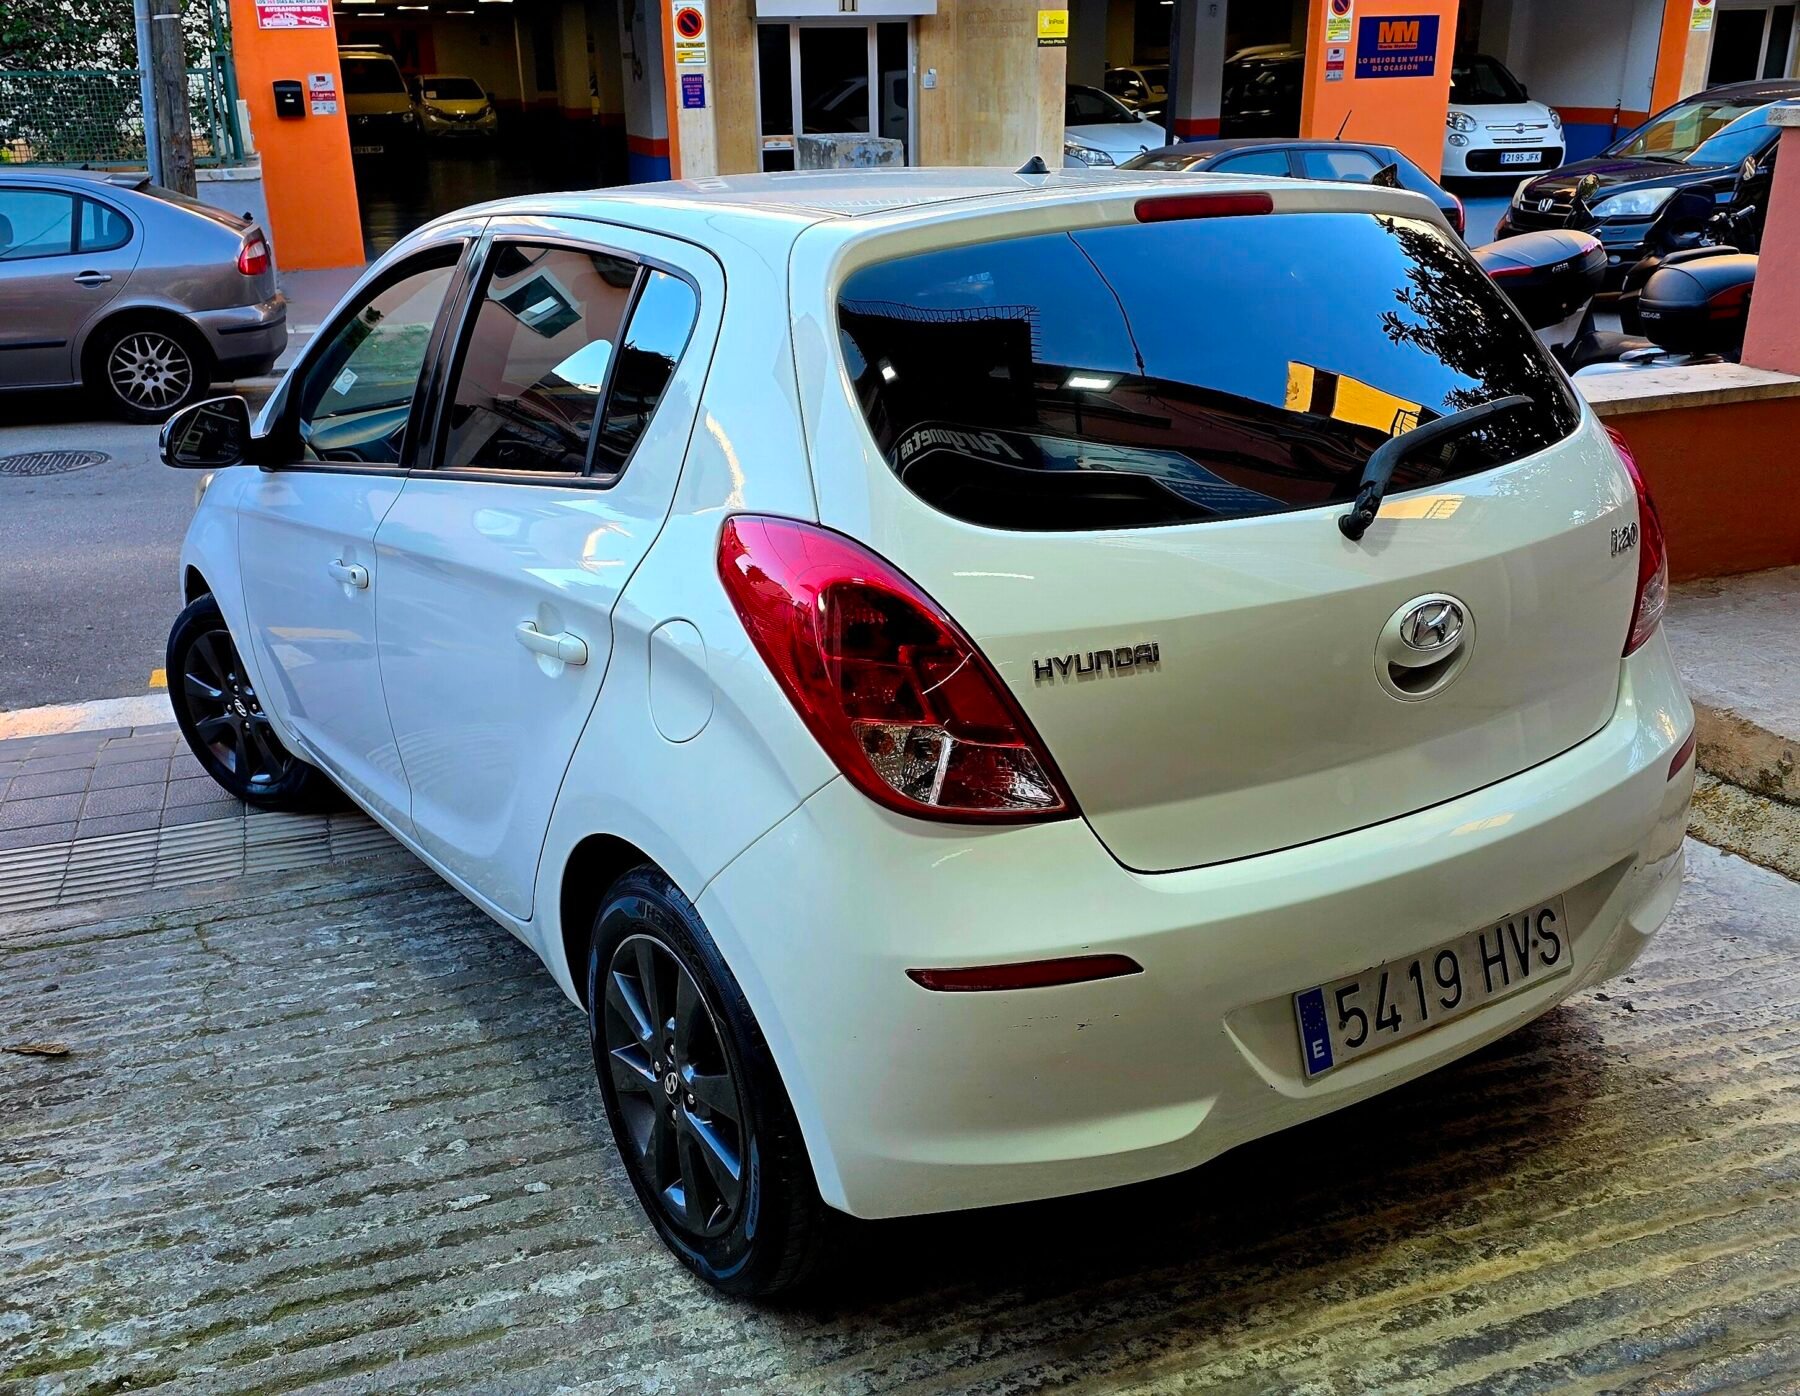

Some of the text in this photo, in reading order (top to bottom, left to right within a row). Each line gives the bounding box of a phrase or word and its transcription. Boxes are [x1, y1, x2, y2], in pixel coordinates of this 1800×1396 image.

[1378, 21, 1420, 43] MM
[1506, 153, 1540, 162] 2195 JFK
[1610, 521, 1638, 557] i20
[1032, 641, 1161, 681] HYUNDAI
[1334, 949, 1463, 1049] 5419
[1478, 908, 1562, 994] HVS
